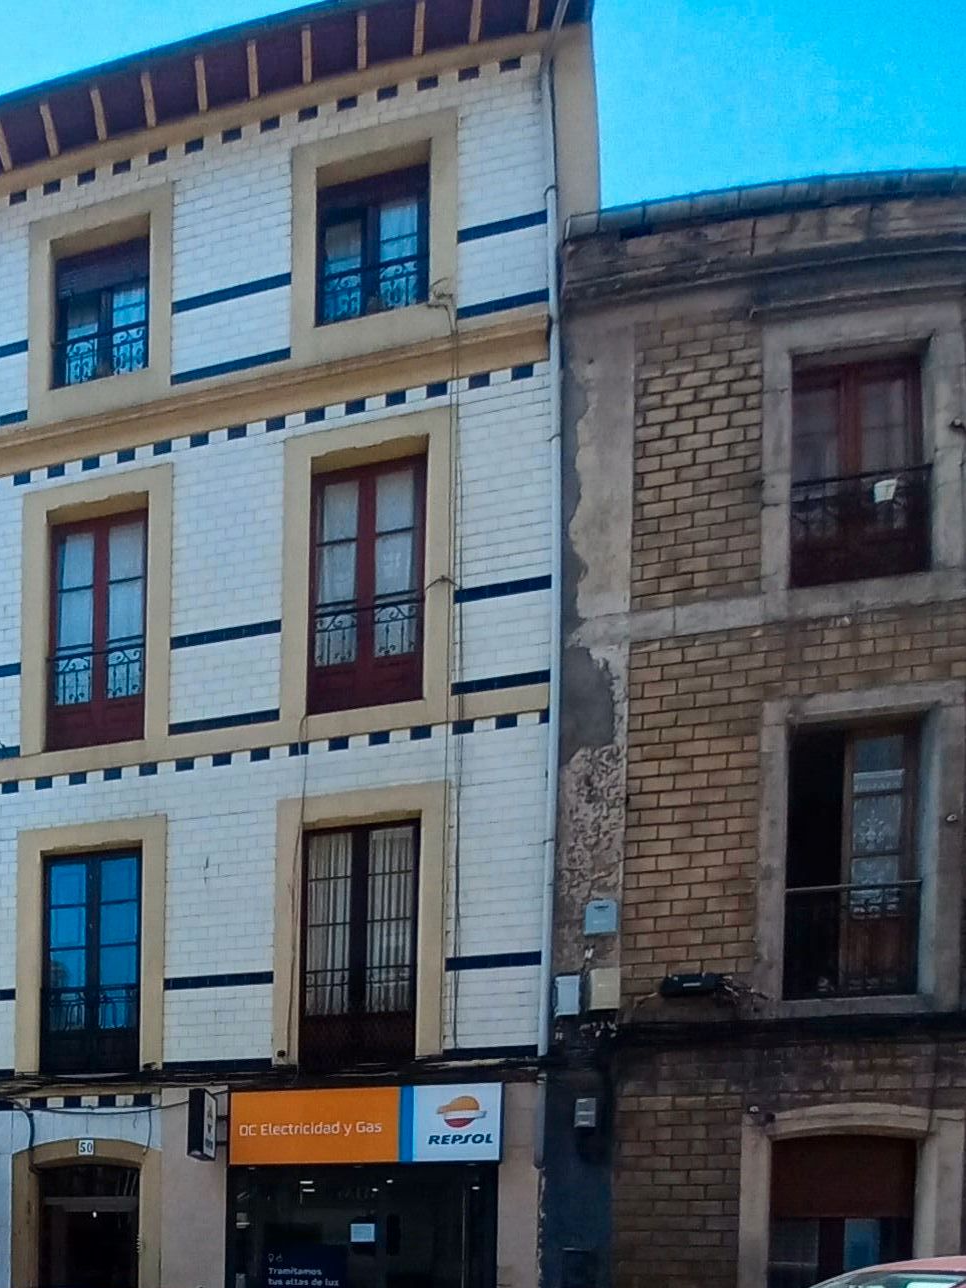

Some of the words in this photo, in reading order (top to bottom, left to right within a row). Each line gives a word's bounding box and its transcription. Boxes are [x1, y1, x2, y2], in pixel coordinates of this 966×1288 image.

[260, 1121, 340, 1135] Electricidad
[343, 1123, 352, 1137] y
[355, 1121, 382, 1133] Gas
[428, 1133, 493, 1145] REPSOL
[79, 1142, 93, 1153] 50
[268, 1266, 322, 1276] Tramitamos
[285, 1278, 309, 1286] altas
[311, 1278, 323, 1286] de
